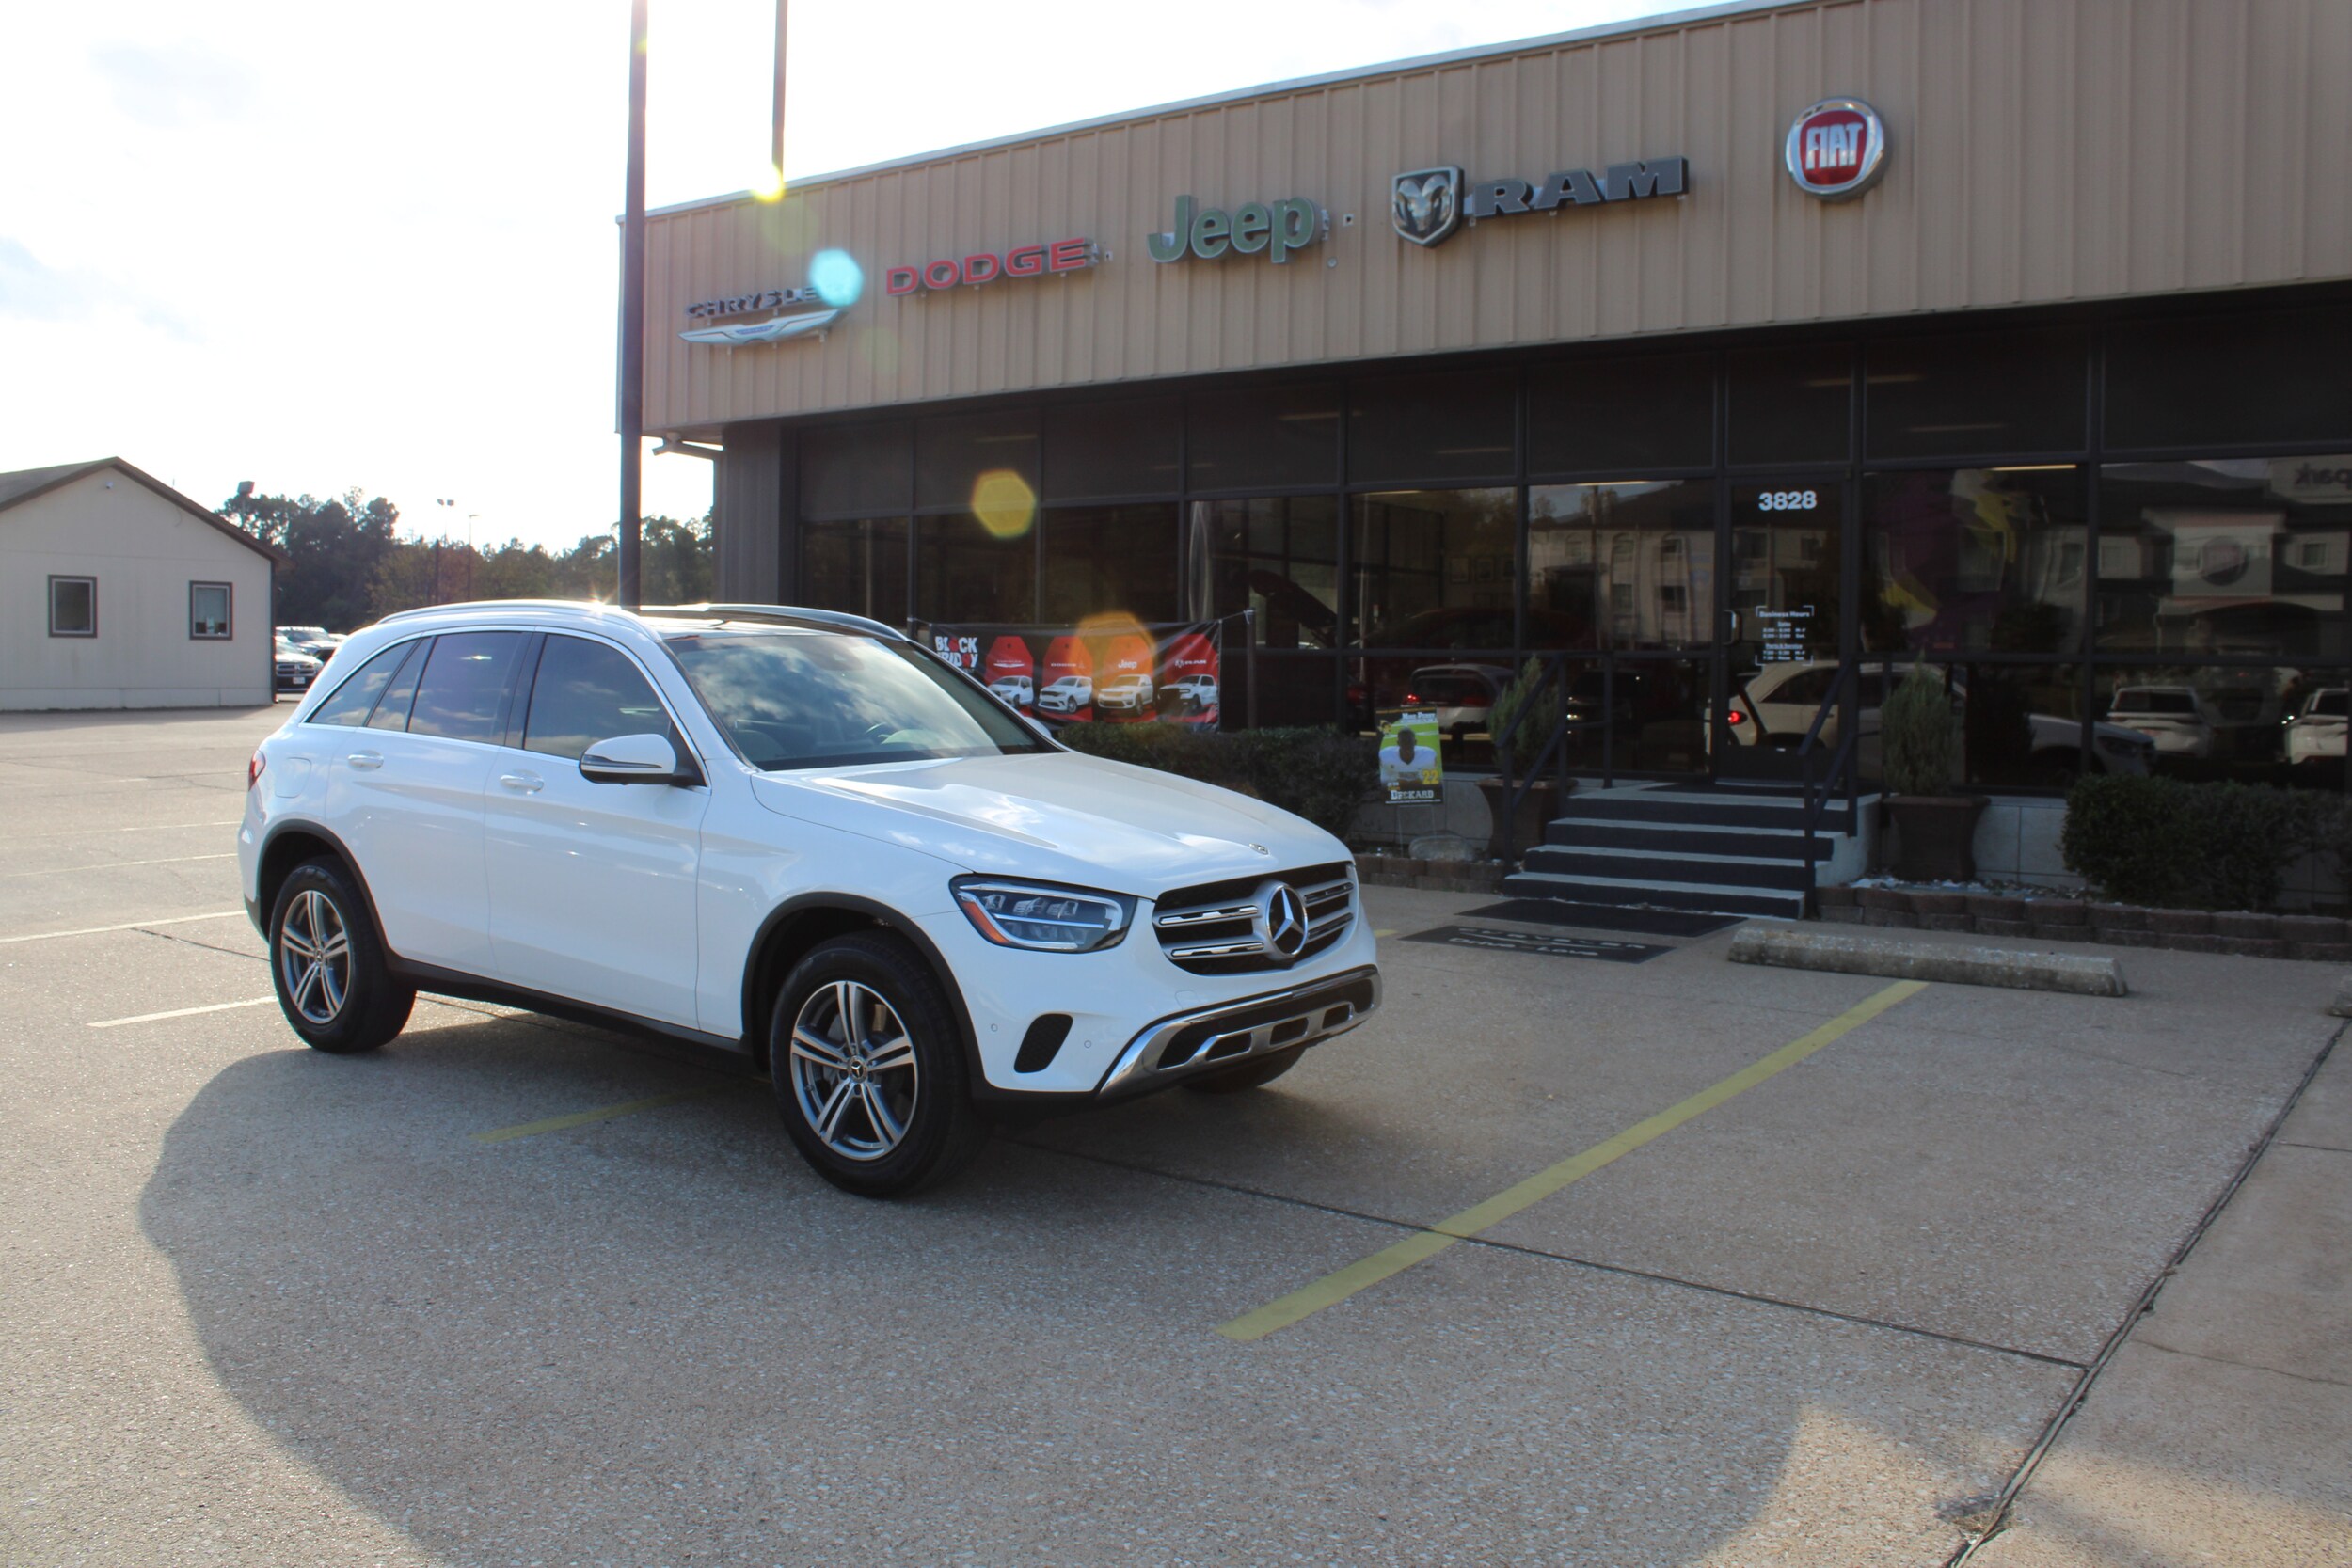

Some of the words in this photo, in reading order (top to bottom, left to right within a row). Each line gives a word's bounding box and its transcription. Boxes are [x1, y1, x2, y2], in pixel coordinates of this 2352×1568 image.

[1805, 121, 1864, 169] FIAT
[1472, 155, 1690, 218] RAM
[1147, 194, 1317, 264] Jeep
[886, 237, 1089, 295] DODGE
[685, 283, 834, 318] CHRYSLE
[1758, 490, 1818, 511] 3828
[1117, 659, 1137, 670] Jeep
[1422, 769, 1439, 784] 22
[1391, 790, 1434, 800] DECKARD
